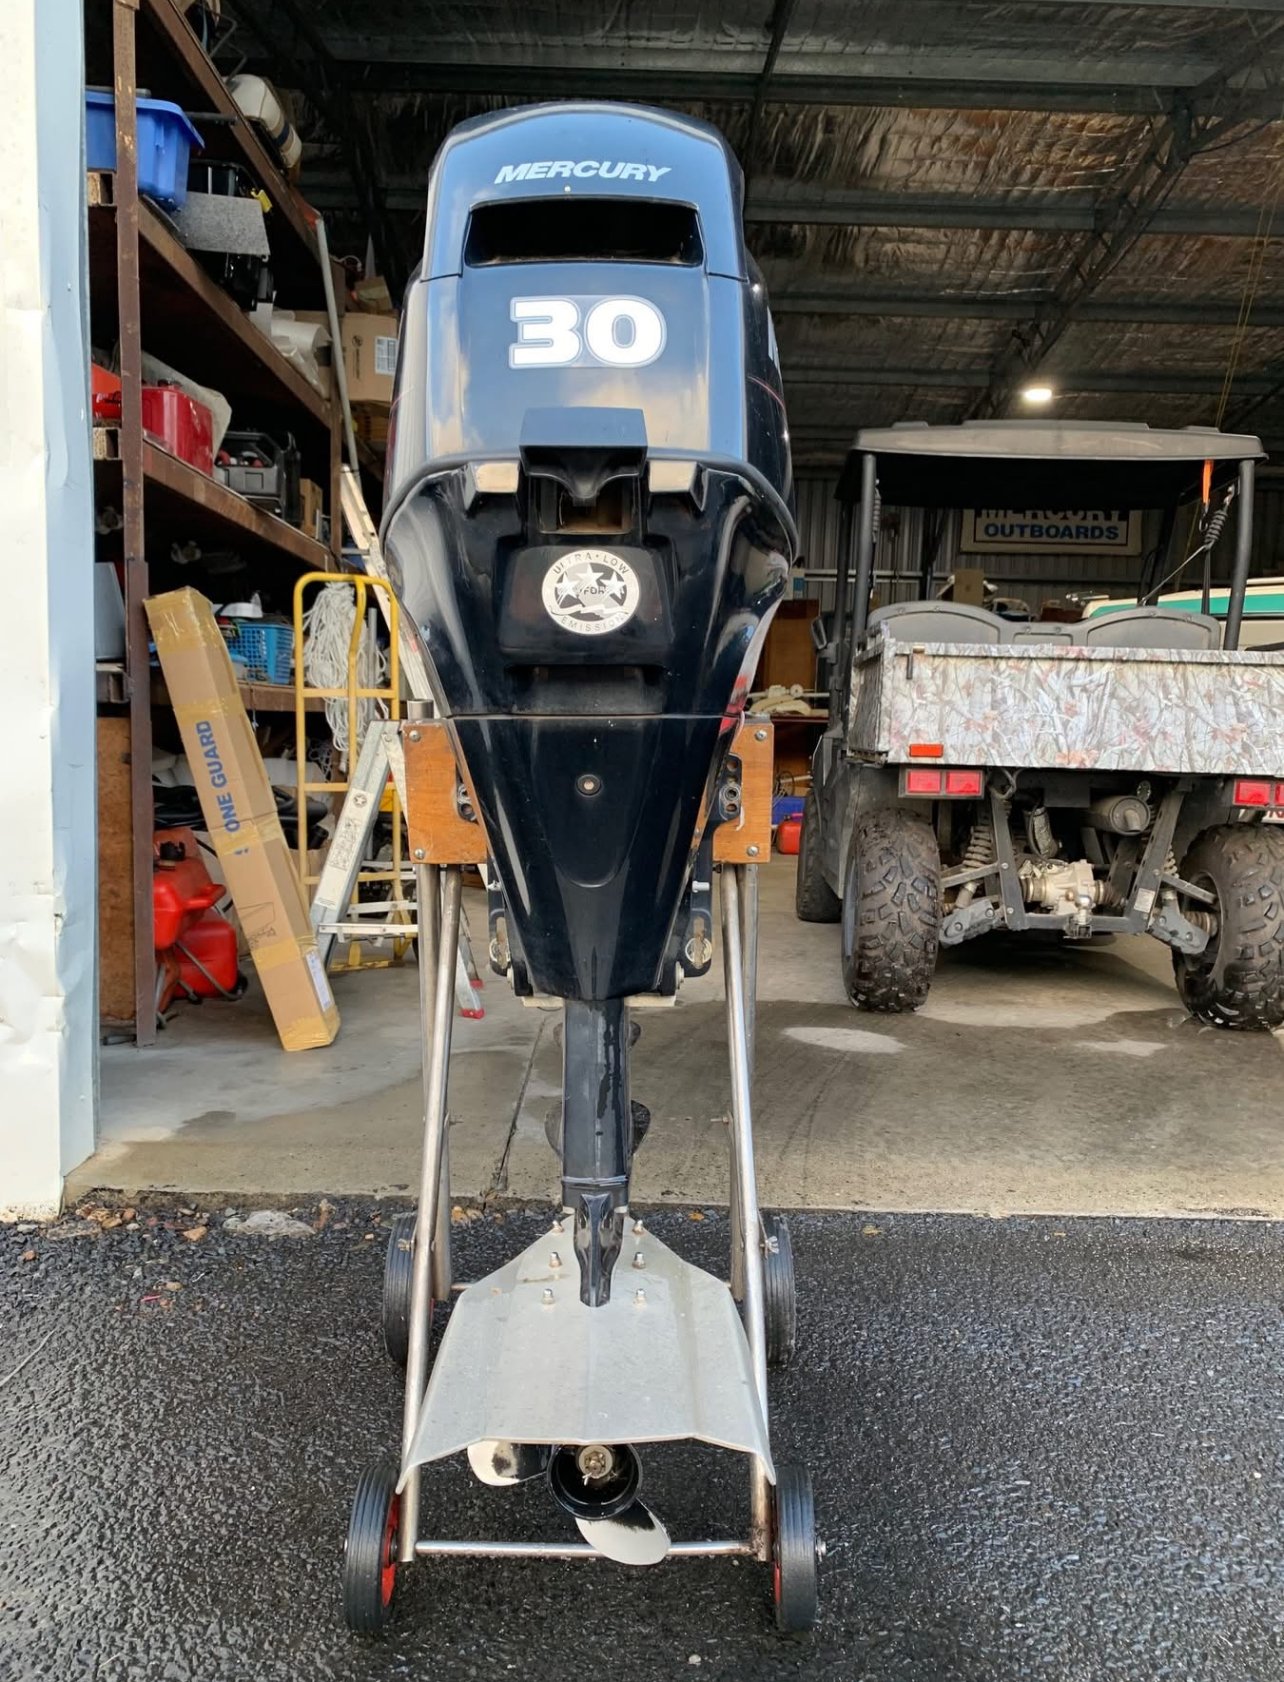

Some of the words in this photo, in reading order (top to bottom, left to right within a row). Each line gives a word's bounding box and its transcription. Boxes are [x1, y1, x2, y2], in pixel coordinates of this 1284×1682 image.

[495, 160, 672, 185] MERCURY
[509, 295, 667, 369] 30
[984, 524, 1119, 541] OUTBOARDS
[603, 555, 629, 574] LOW
[196, 720, 227, 788] GUARD
[217, 792, 240, 832] ONE
